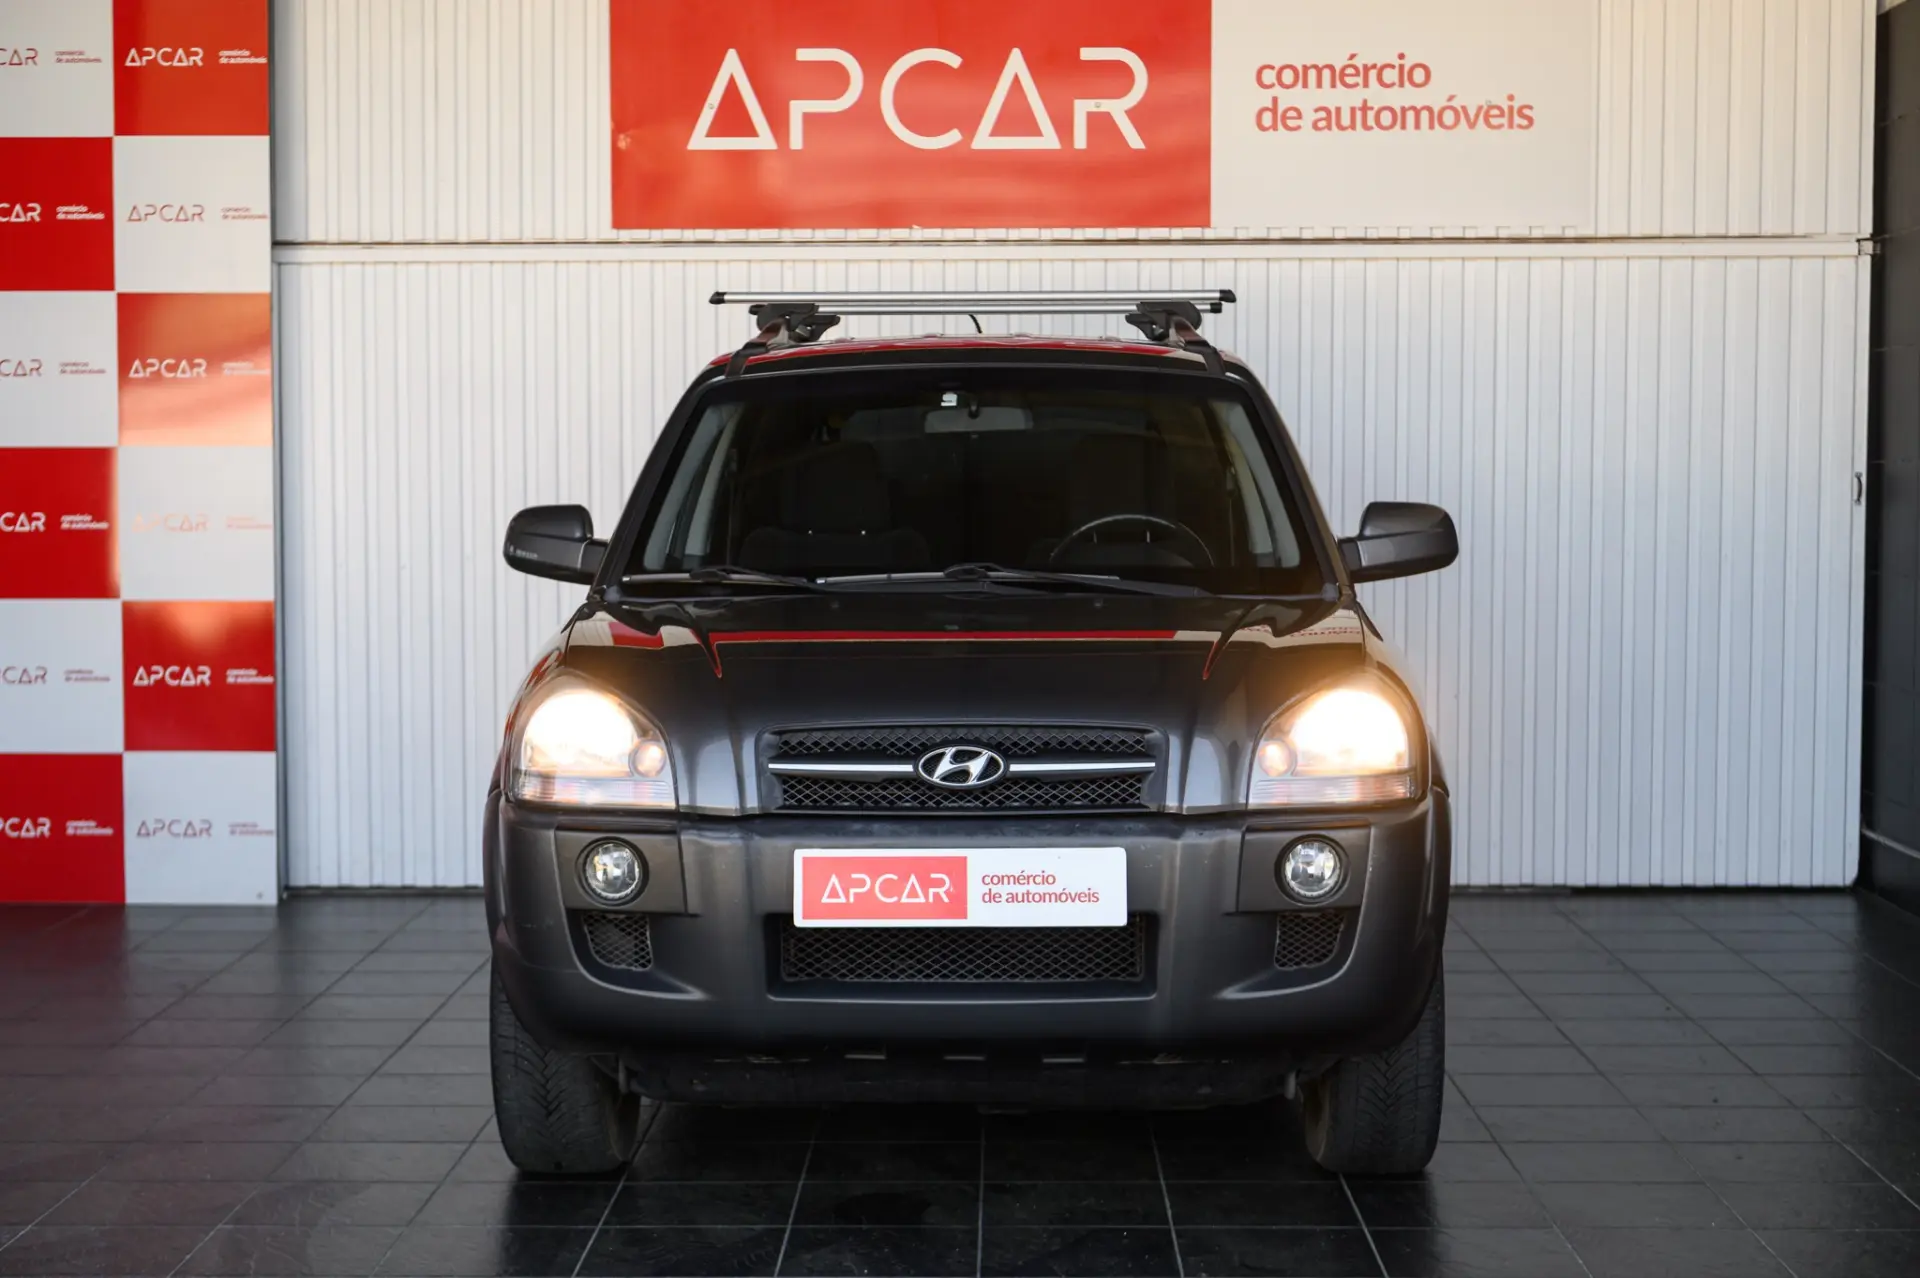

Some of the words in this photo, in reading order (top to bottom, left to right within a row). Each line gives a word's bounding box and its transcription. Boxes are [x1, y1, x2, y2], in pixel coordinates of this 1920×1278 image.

[124, 48, 204, 67] APCAR
[1255, 52, 1431, 90] comércio
[686, 47, 1149, 151] APCAR
[1256, 96, 1303, 132] de
[1312, 94, 1534, 132] automóveis
[127, 204, 205, 222] APCAR
[128, 359, 207, 379] APCAR
[133, 665, 211, 686] APCAR
[136, 818, 213, 838] APCAR
[821, 873, 951, 903] APCAR
[982, 870, 1056, 886] comércio
[982, 887, 1002, 903] de
[1005, 887, 1099, 903] automóveis
